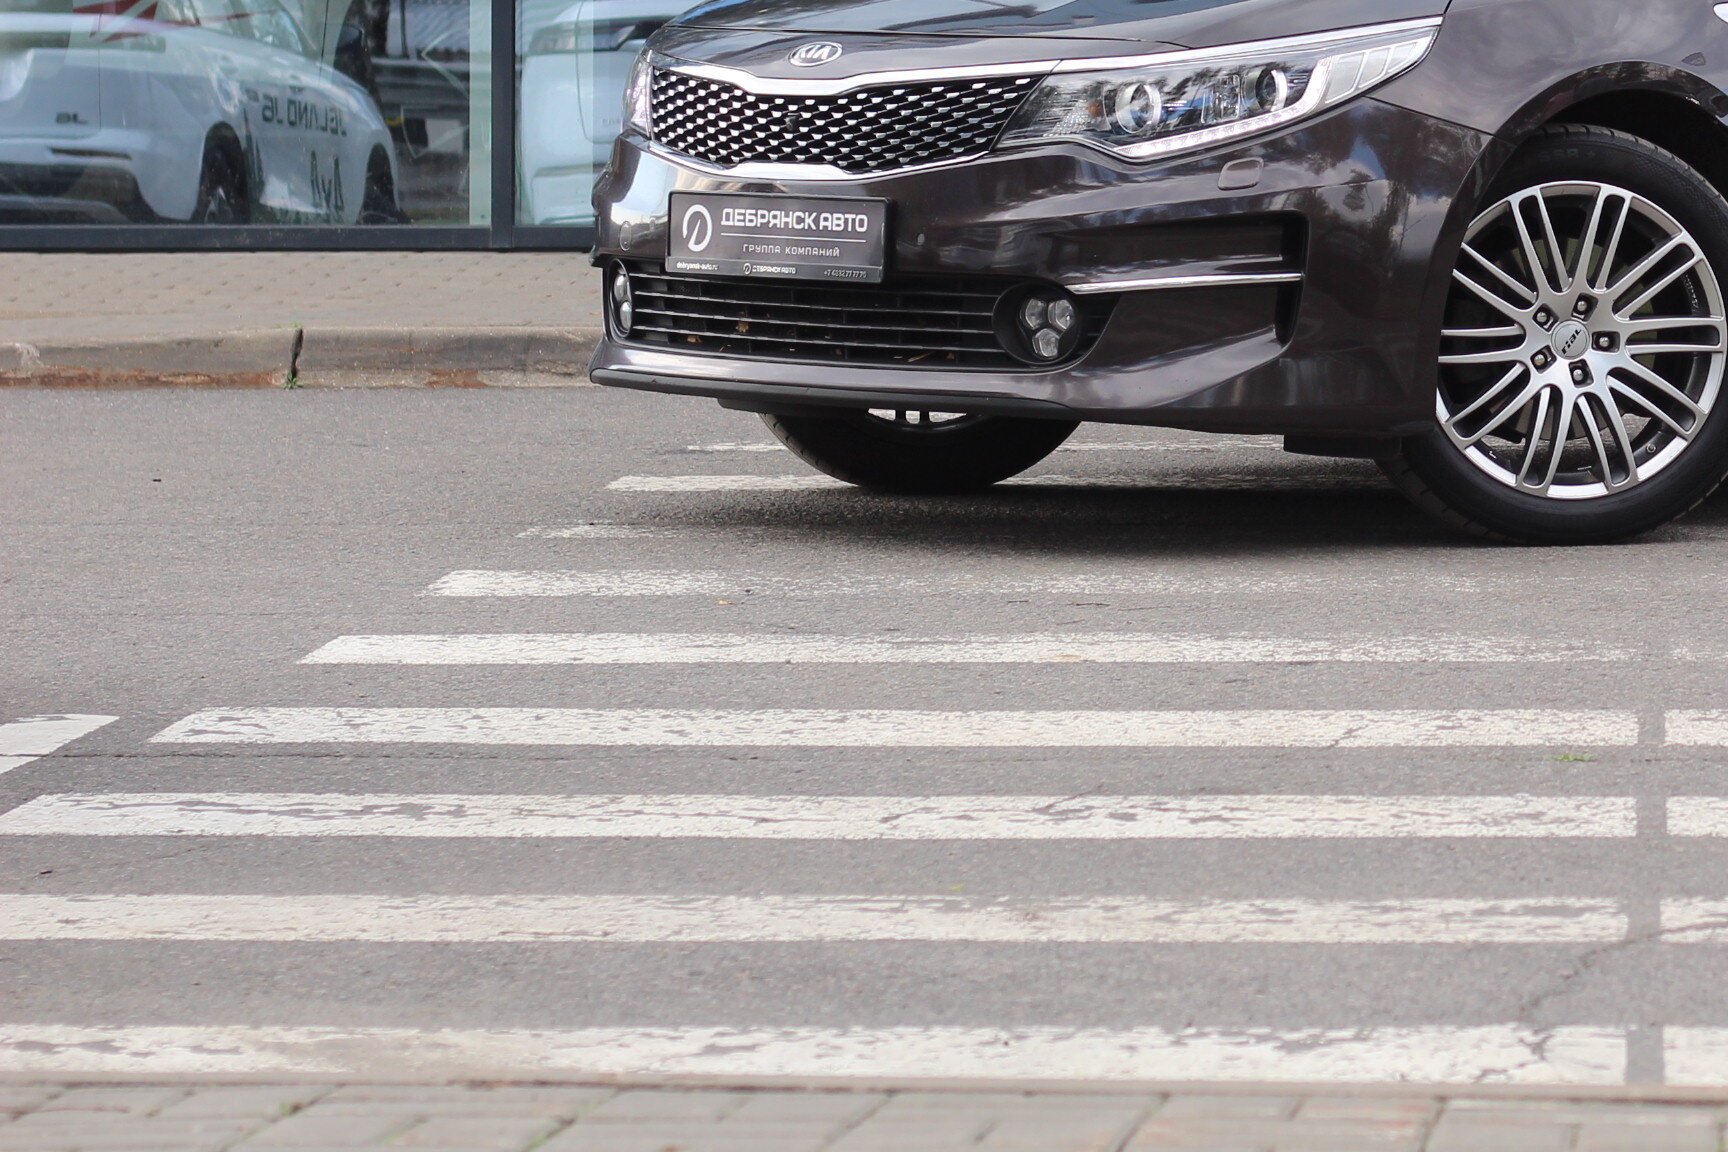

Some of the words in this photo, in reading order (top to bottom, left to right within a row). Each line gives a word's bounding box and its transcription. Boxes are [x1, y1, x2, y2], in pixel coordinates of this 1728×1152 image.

[795, 43, 834, 60] KIA
[720, 208, 817, 230] ДЕБРЯНСК
[819, 212, 868, 232] АВТО
[743, 243, 781, 254] ГРУППА
[785, 246, 840, 257] КОМПАНИЙ
[1561, 328, 1582, 355] rial
